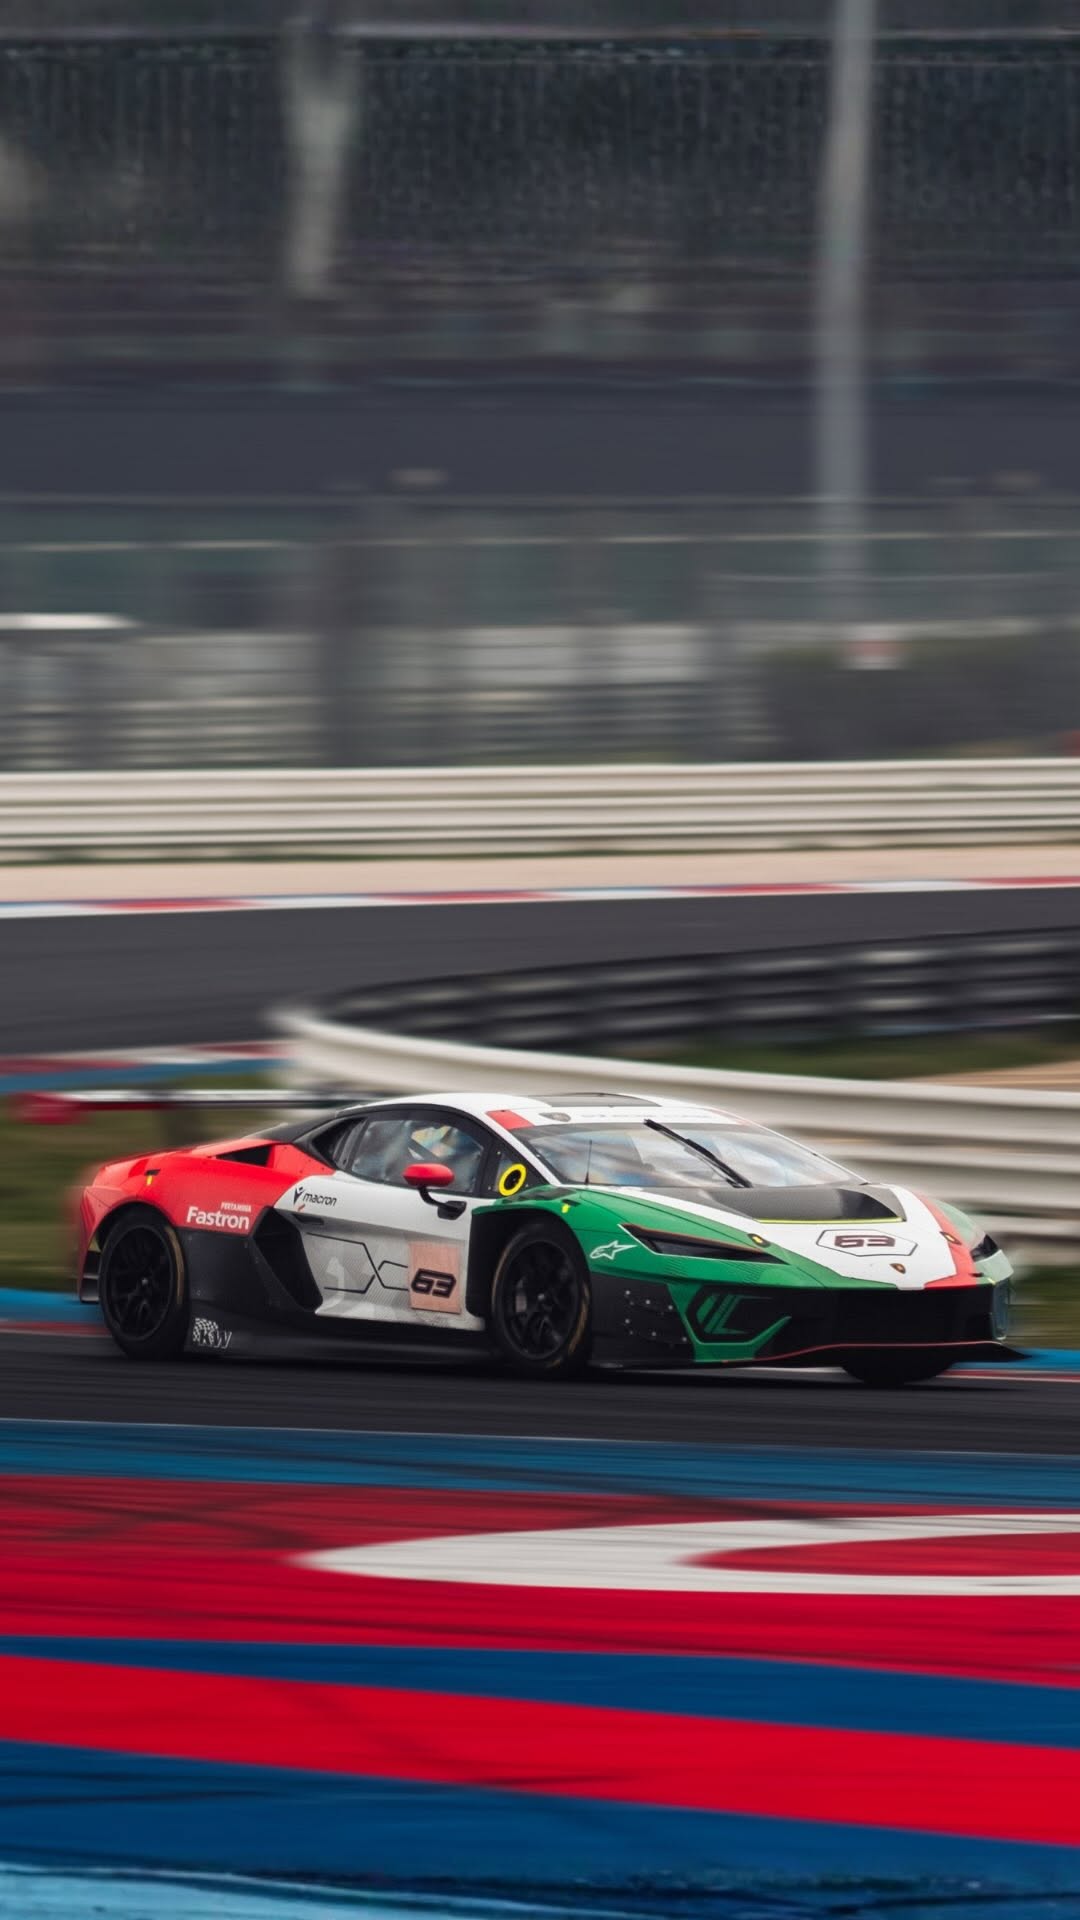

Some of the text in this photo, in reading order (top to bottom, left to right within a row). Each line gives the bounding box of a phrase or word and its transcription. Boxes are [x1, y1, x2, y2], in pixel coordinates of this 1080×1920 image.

[303, 1192, 337, 1206] macron
[187, 1206, 250, 1230] Fastron
[834, 1234, 896, 1248] 63
[411, 1268, 457, 1298] 63
